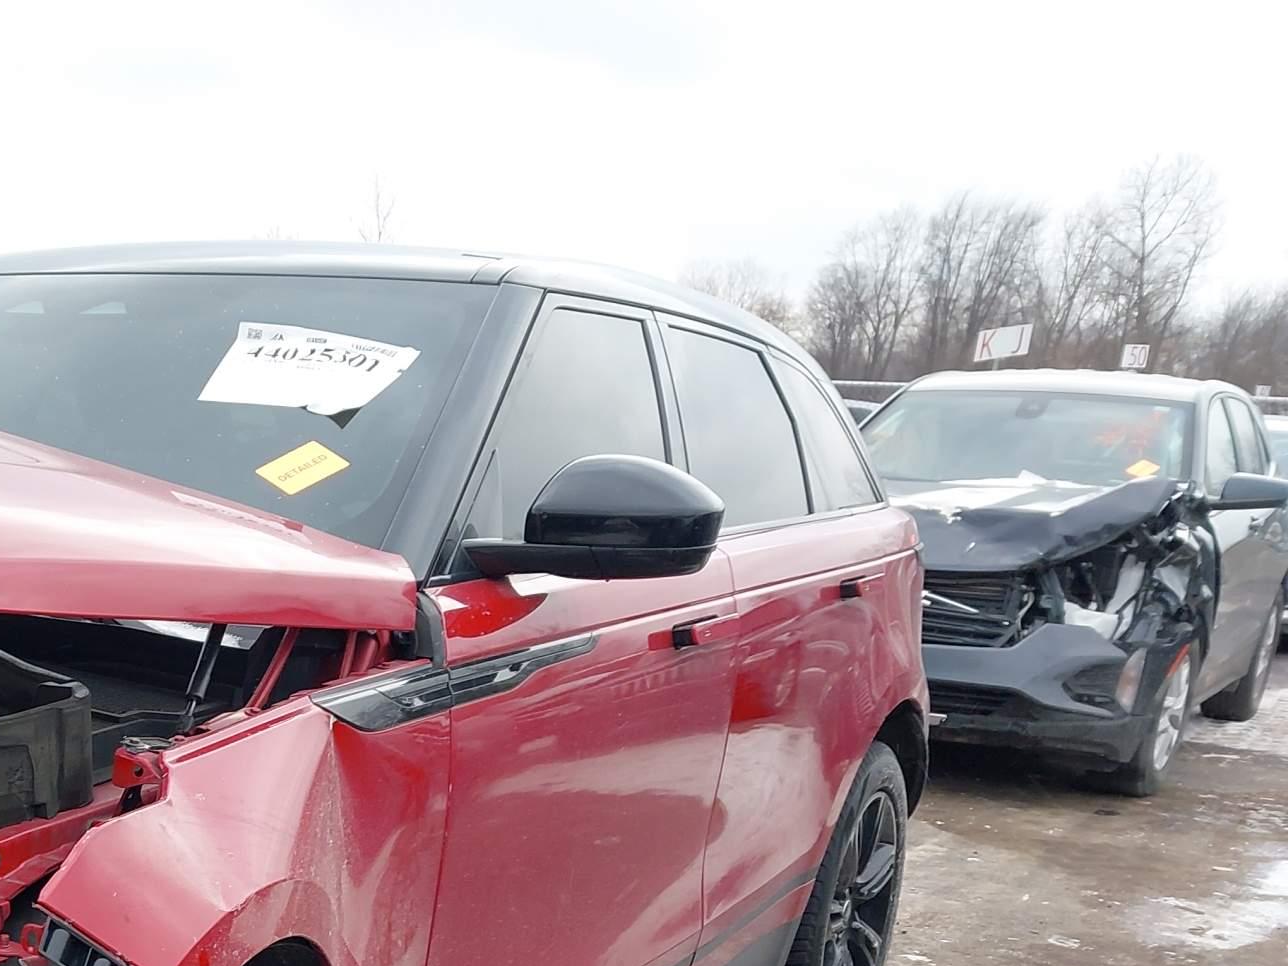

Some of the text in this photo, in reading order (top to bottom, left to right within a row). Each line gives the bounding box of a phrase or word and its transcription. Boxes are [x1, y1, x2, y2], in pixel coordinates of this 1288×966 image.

[979, 326, 1024, 358] K J
[1127, 346, 1148, 366] 50
[278, 454, 328, 482] DETAILED
